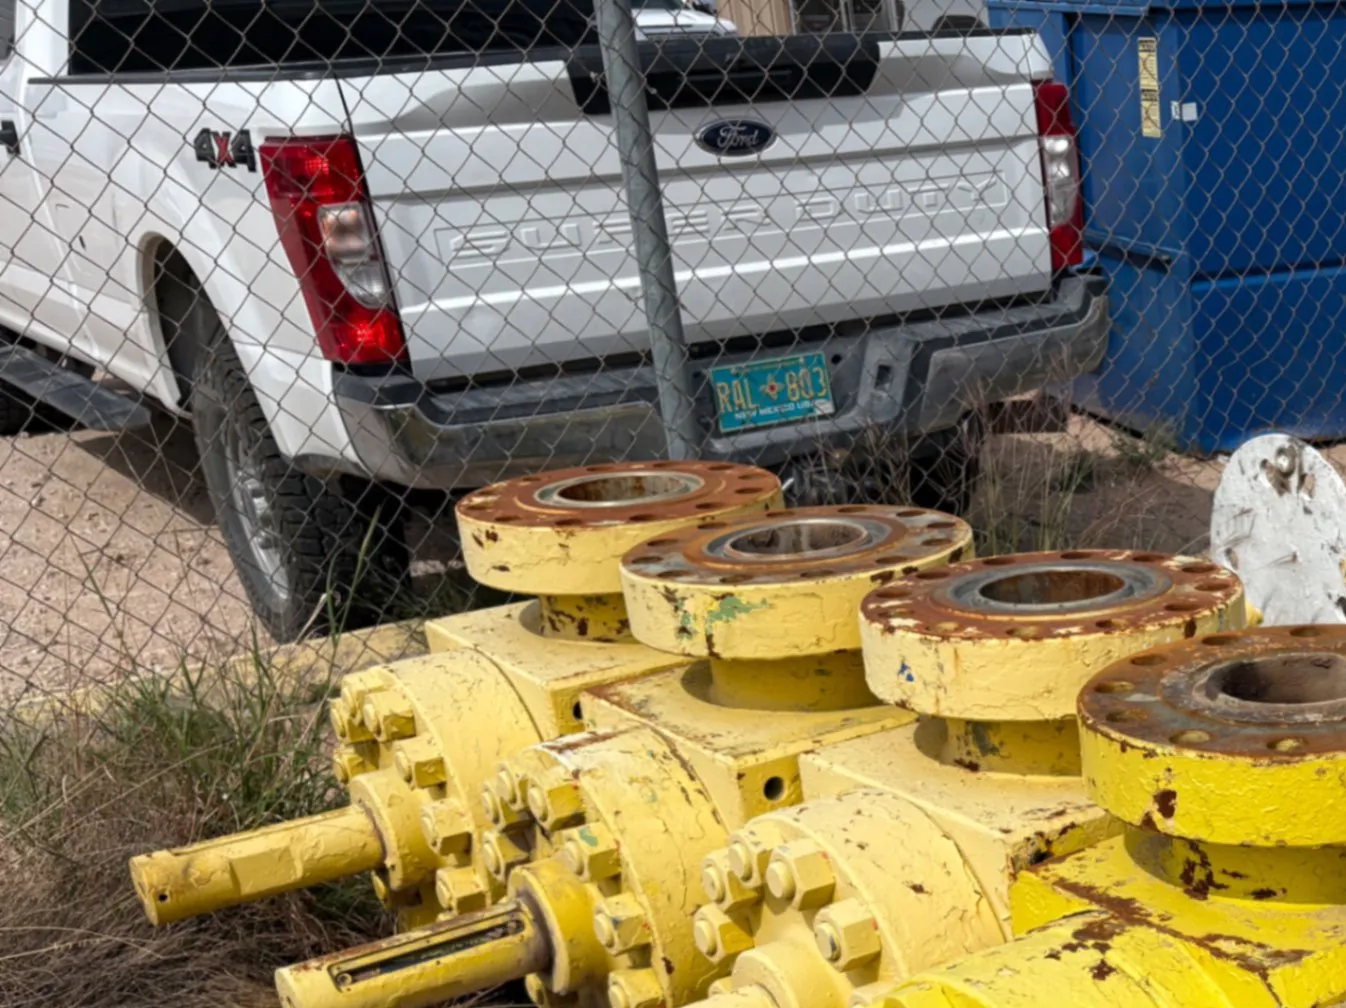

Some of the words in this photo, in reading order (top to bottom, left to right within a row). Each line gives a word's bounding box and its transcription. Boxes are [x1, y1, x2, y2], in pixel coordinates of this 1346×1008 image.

[717, 126, 759, 148] Ford
[452, 203, 772, 260] SUPER
[796, 175, 998, 223] DUTY
[716, 378, 759, 414] RAL
[786, 366, 828, 403] 803
